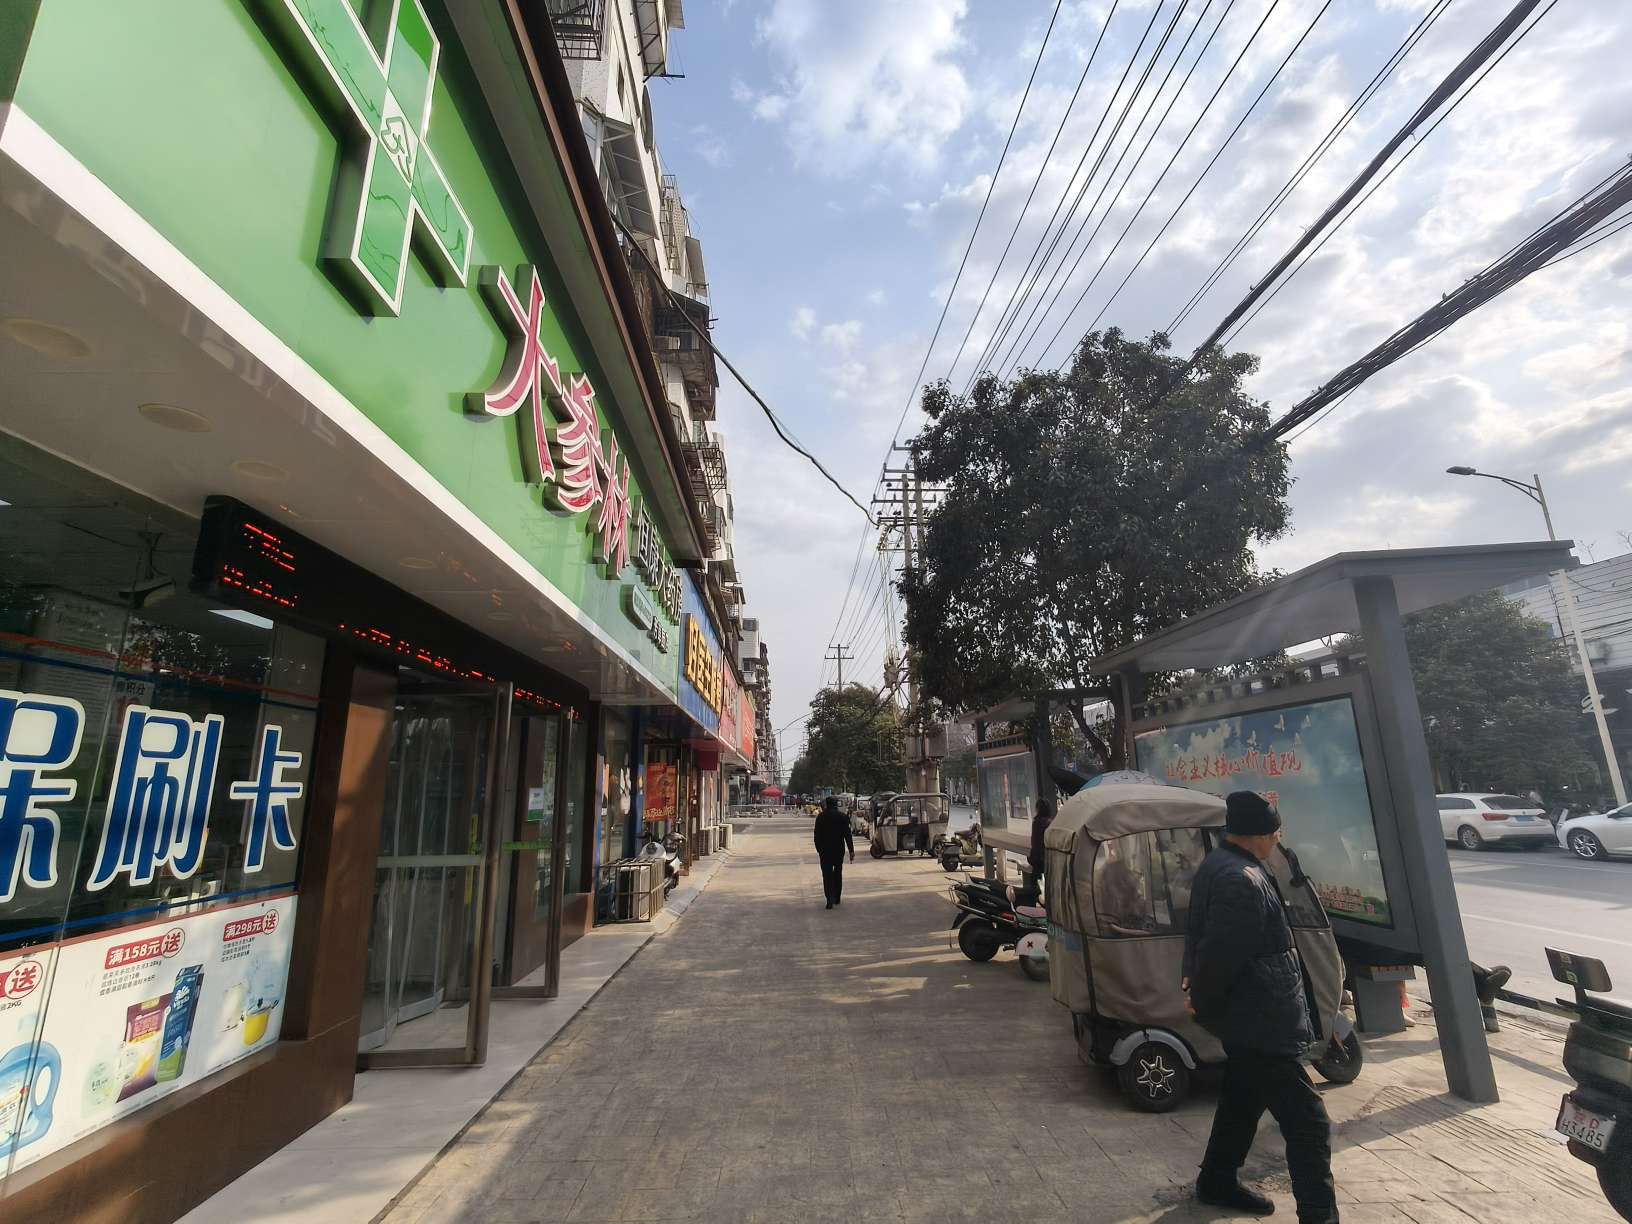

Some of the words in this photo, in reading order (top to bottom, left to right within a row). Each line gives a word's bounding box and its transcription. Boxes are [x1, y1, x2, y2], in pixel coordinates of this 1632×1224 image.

[225, 912, 277, 939] 满298元送
[108, 931, 181, 966] 满158元送
